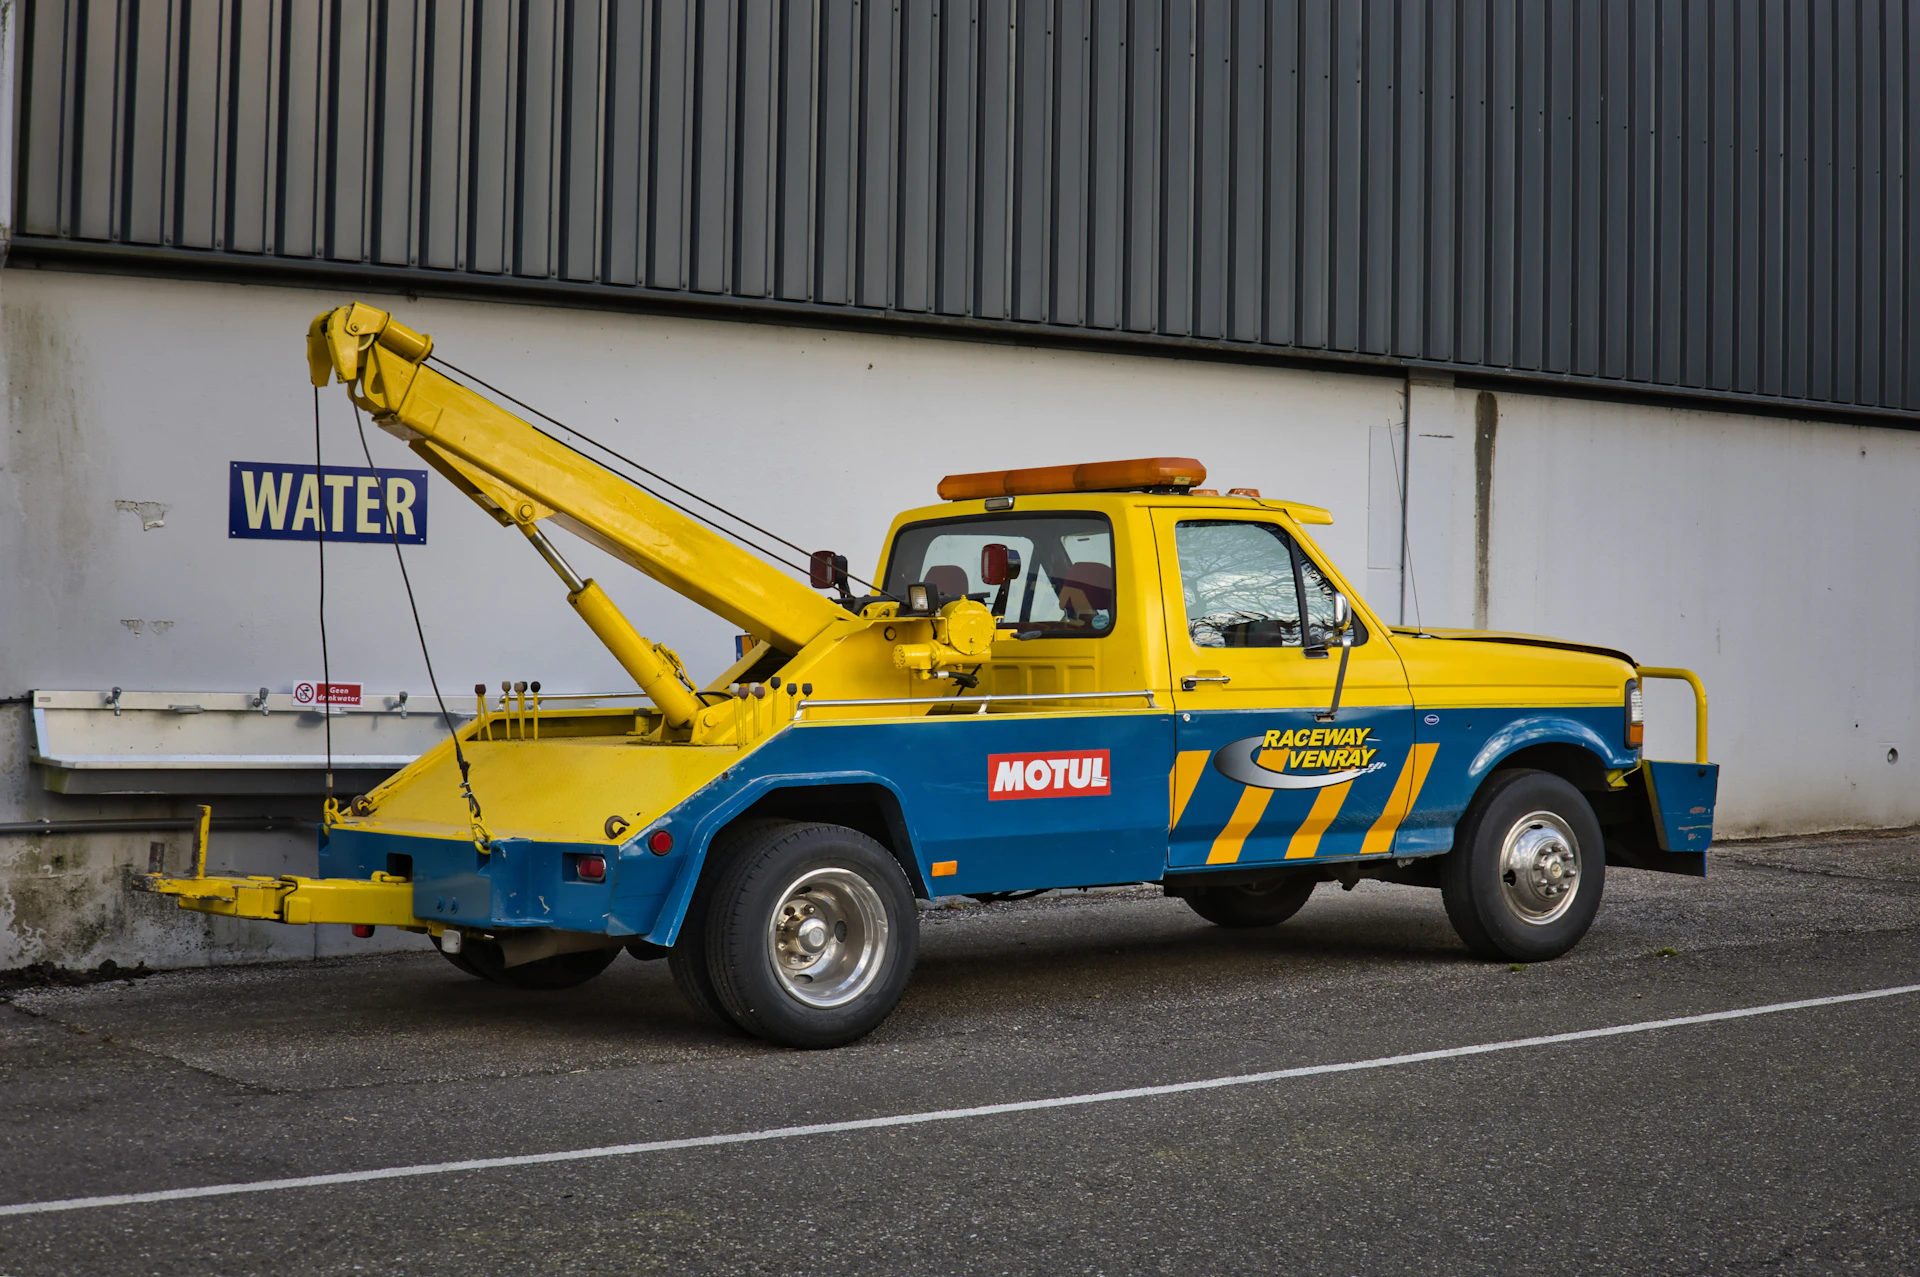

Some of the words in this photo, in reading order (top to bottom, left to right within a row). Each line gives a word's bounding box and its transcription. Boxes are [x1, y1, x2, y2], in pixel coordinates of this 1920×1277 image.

[241, 471, 416, 535] WATER
[317, 694, 359, 702] drnkwater
[329, 686, 349, 694] Geen
[1262, 727, 1372, 748] RACEWAY
[1289, 748, 1377, 769] VENRAY
[993, 757, 1108, 792] MOTUL
